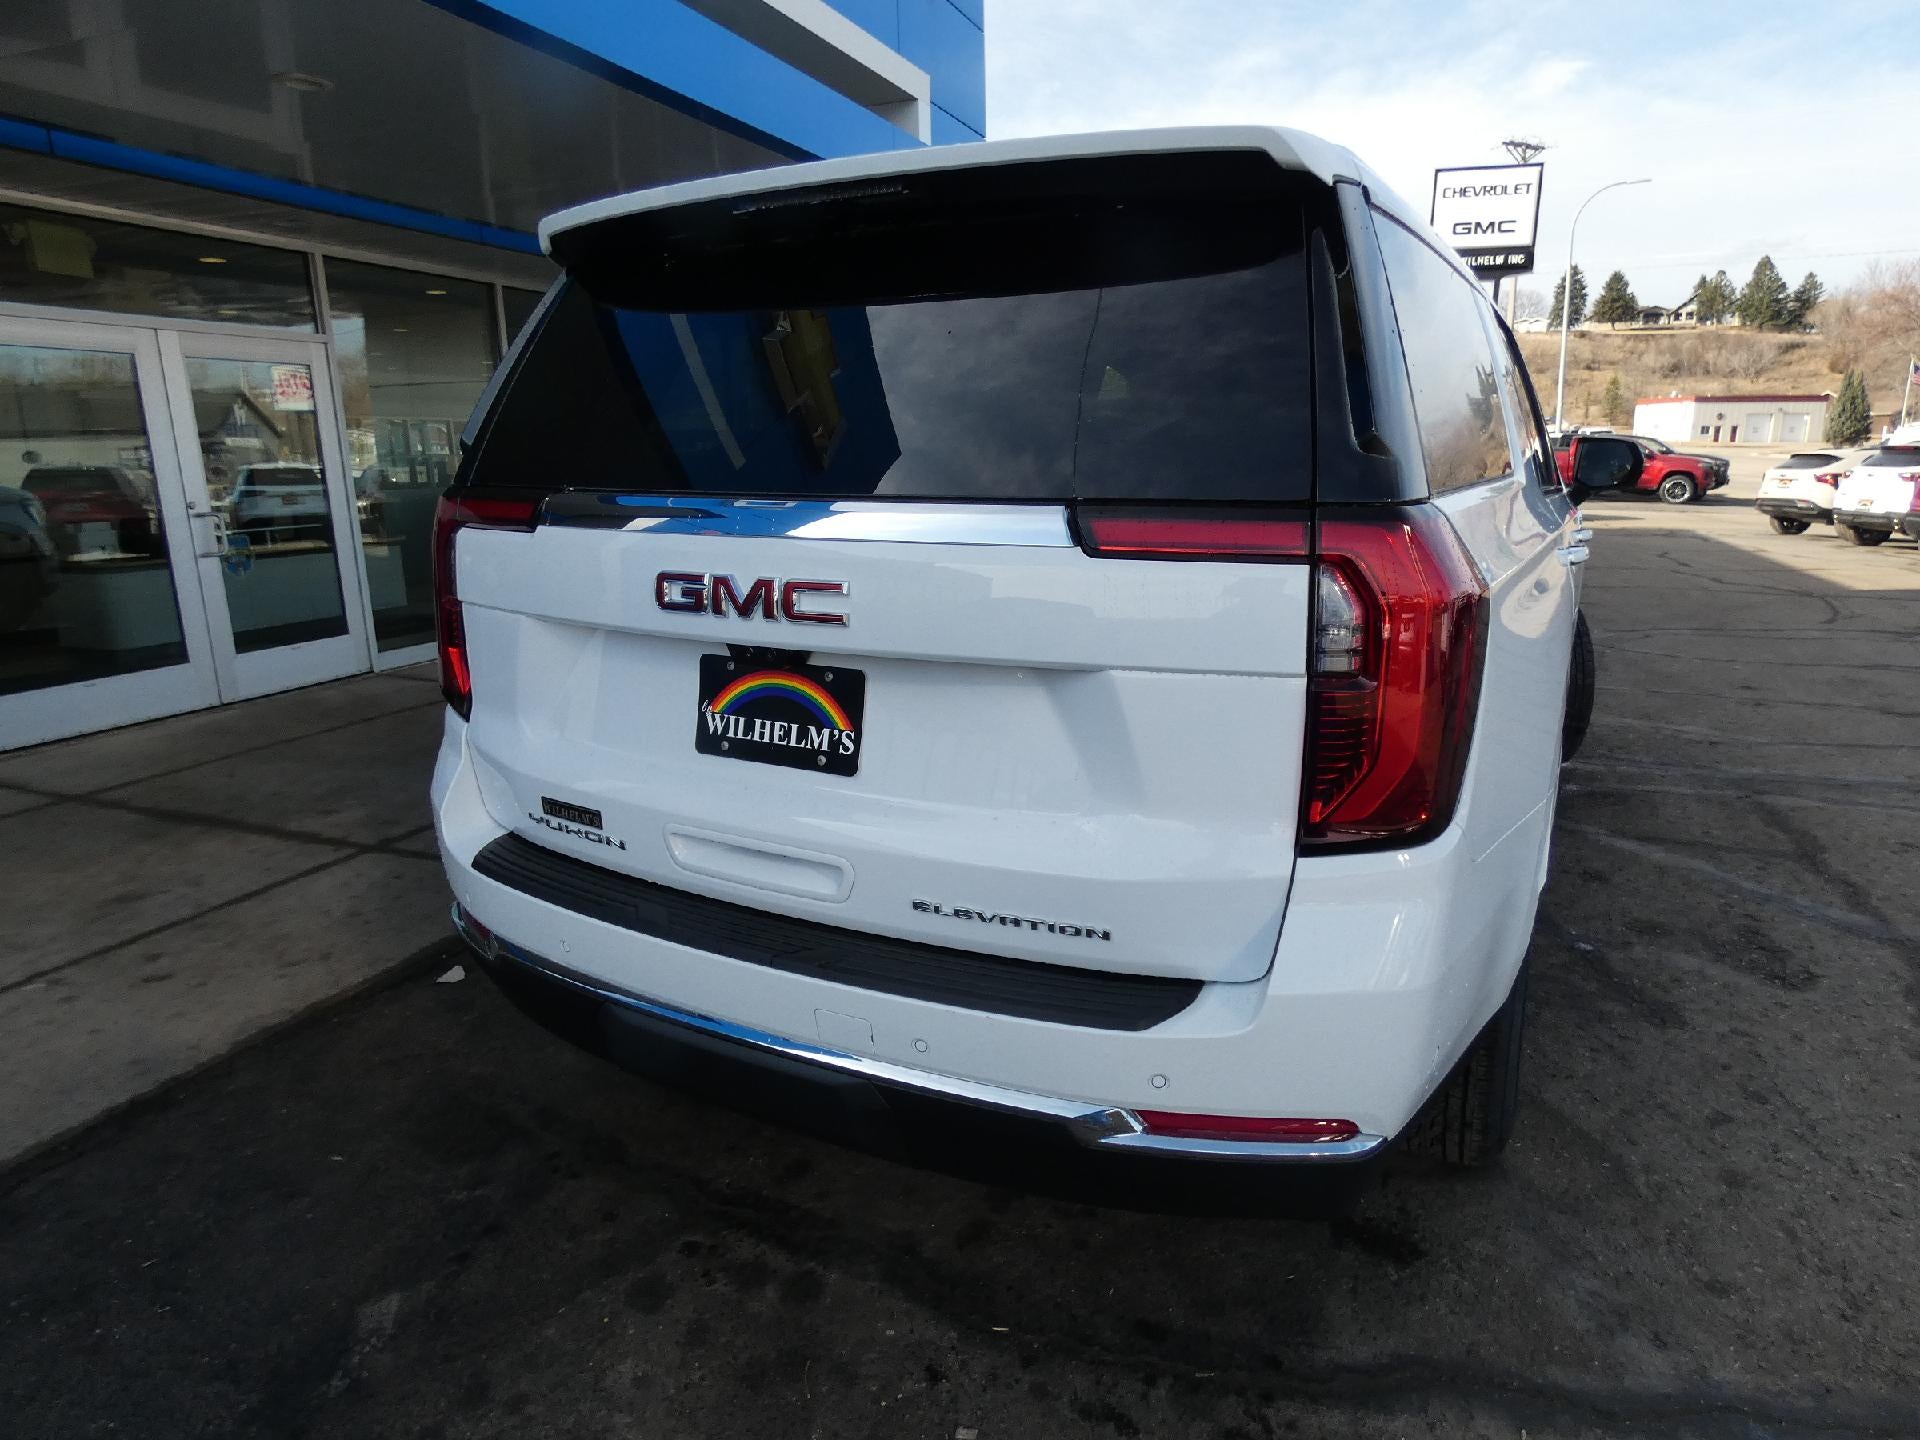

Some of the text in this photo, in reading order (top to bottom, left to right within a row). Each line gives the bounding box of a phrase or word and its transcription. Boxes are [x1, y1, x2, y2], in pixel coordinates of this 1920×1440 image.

[1442, 183, 1533, 199] CHEVROLET
[1452, 220, 1517, 235] GMC
[655, 570, 849, 628] GMC
[705, 711, 856, 755] WILHELM'S
[528, 812, 627, 850] YUKON
[912, 899, 1112, 942] ELEVATION
